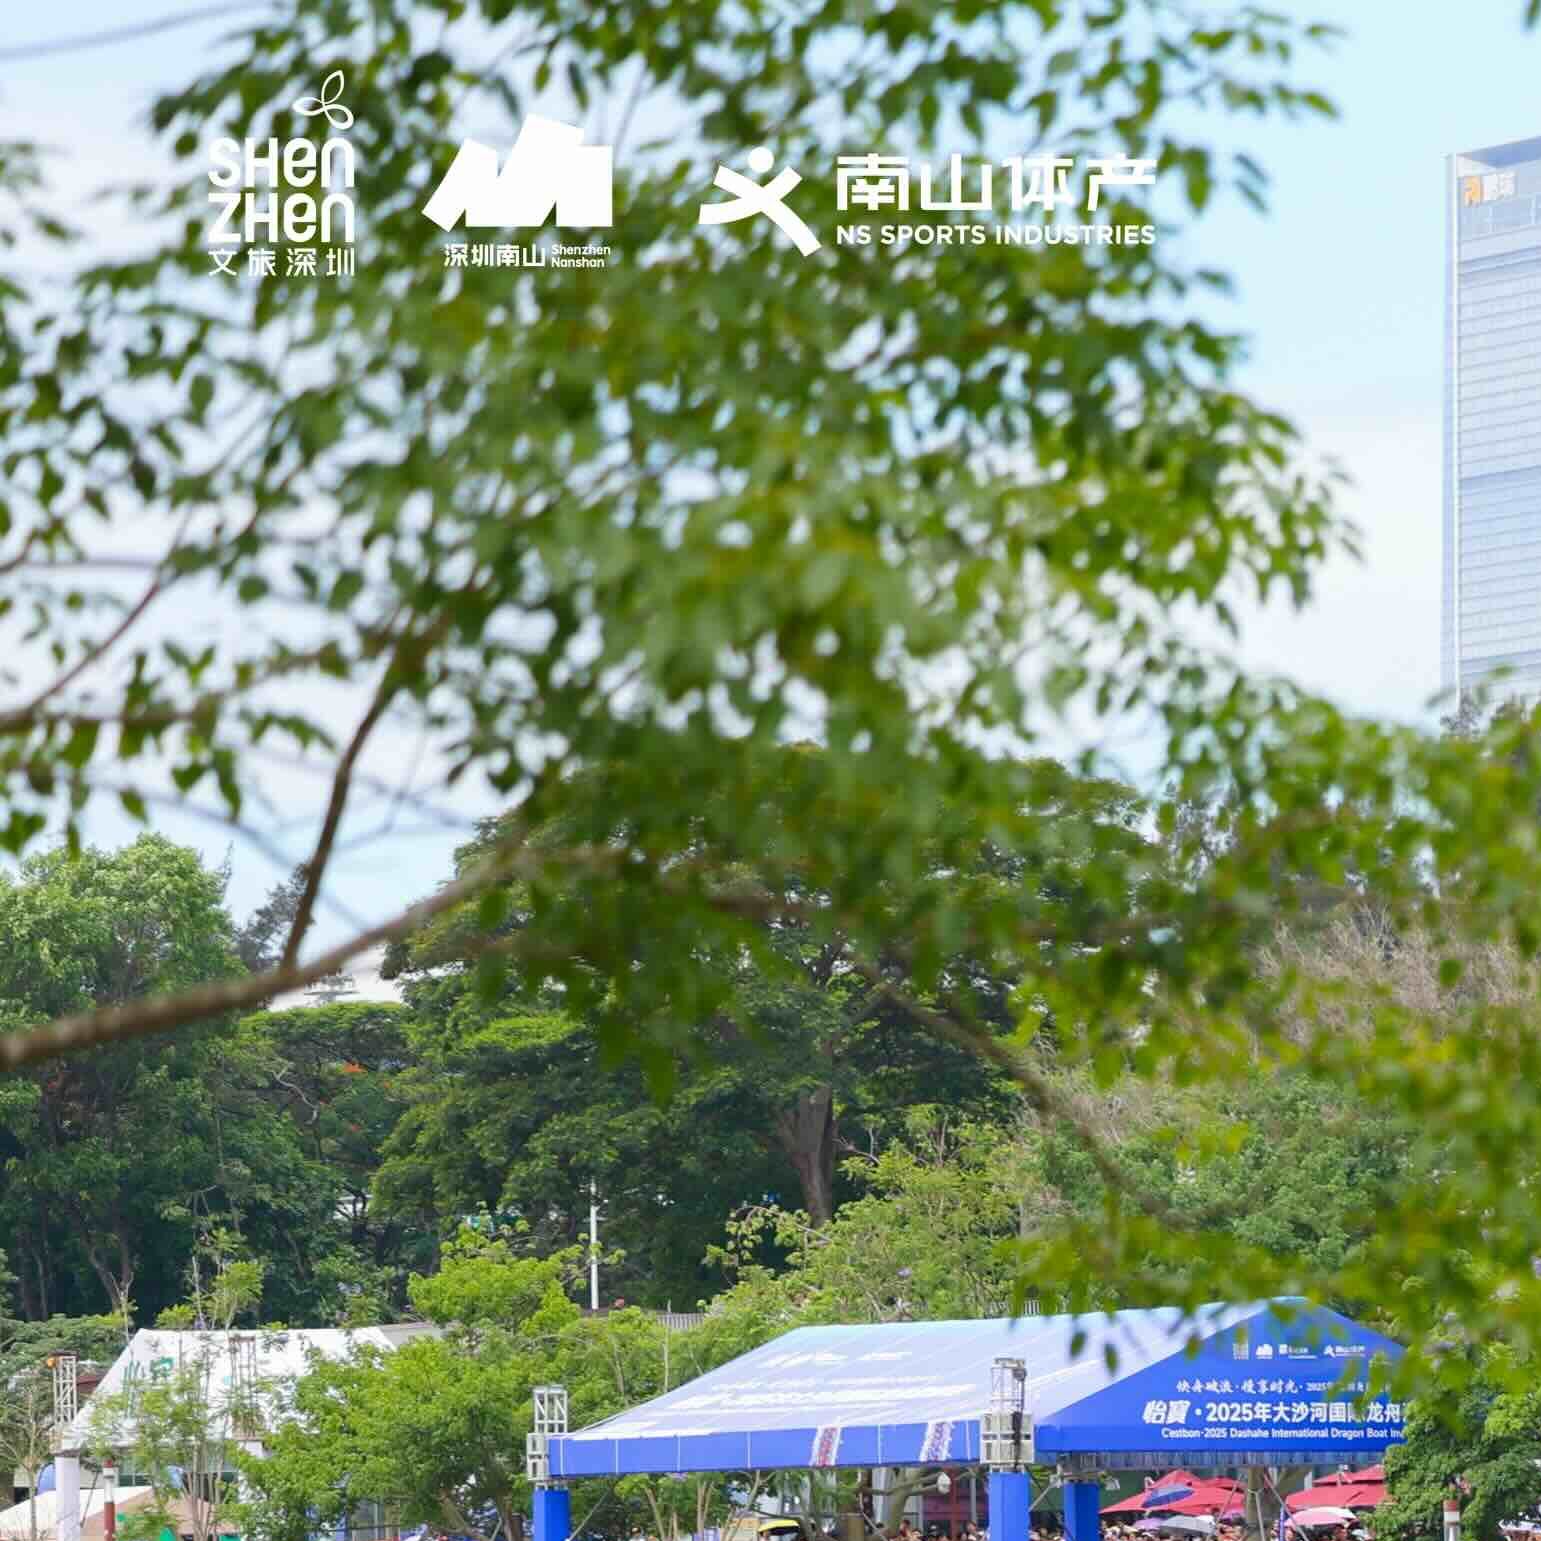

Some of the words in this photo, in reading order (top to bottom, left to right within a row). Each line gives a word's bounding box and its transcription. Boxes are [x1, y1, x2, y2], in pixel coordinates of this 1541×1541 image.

[1229, 1427, 1269, 1438] Dashahe
[1271, 1427, 1329, 1438] International
[1330, 1427, 1364, 1440] Dragon
[1366, 1427, 1388, 1438] Boat
